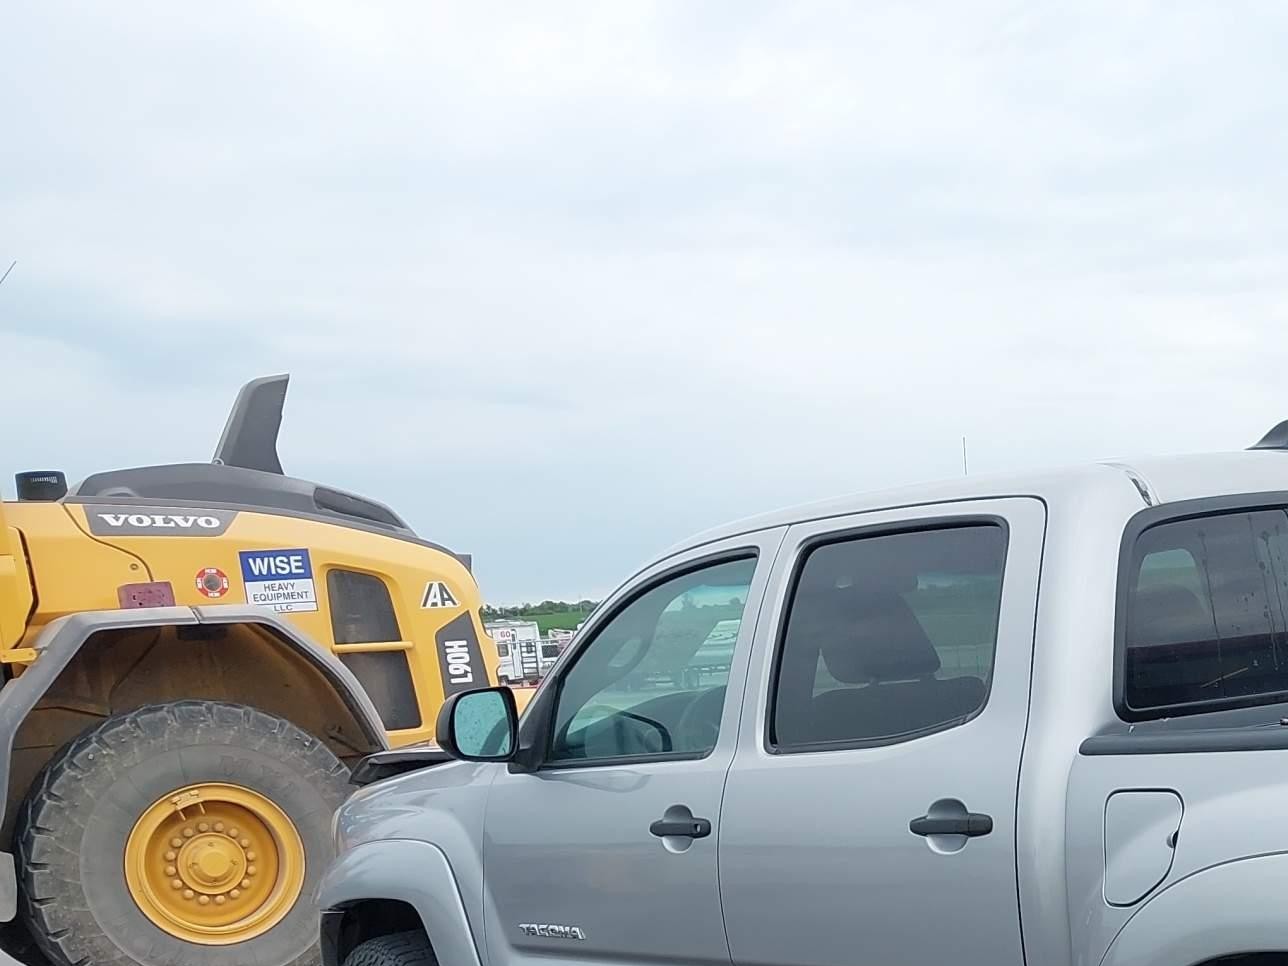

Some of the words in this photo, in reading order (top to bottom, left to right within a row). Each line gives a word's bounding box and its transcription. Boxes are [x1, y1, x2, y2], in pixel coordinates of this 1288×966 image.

[98, 513, 220, 528] VOLVO
[248, 555, 305, 576] WISE
[263, 582, 296, 592] HEAVY
[253, 591, 309, 602] EQUIPMENT
[274, 604, 293, 612] LLC
[519, 923, 586, 940] TACOMA
